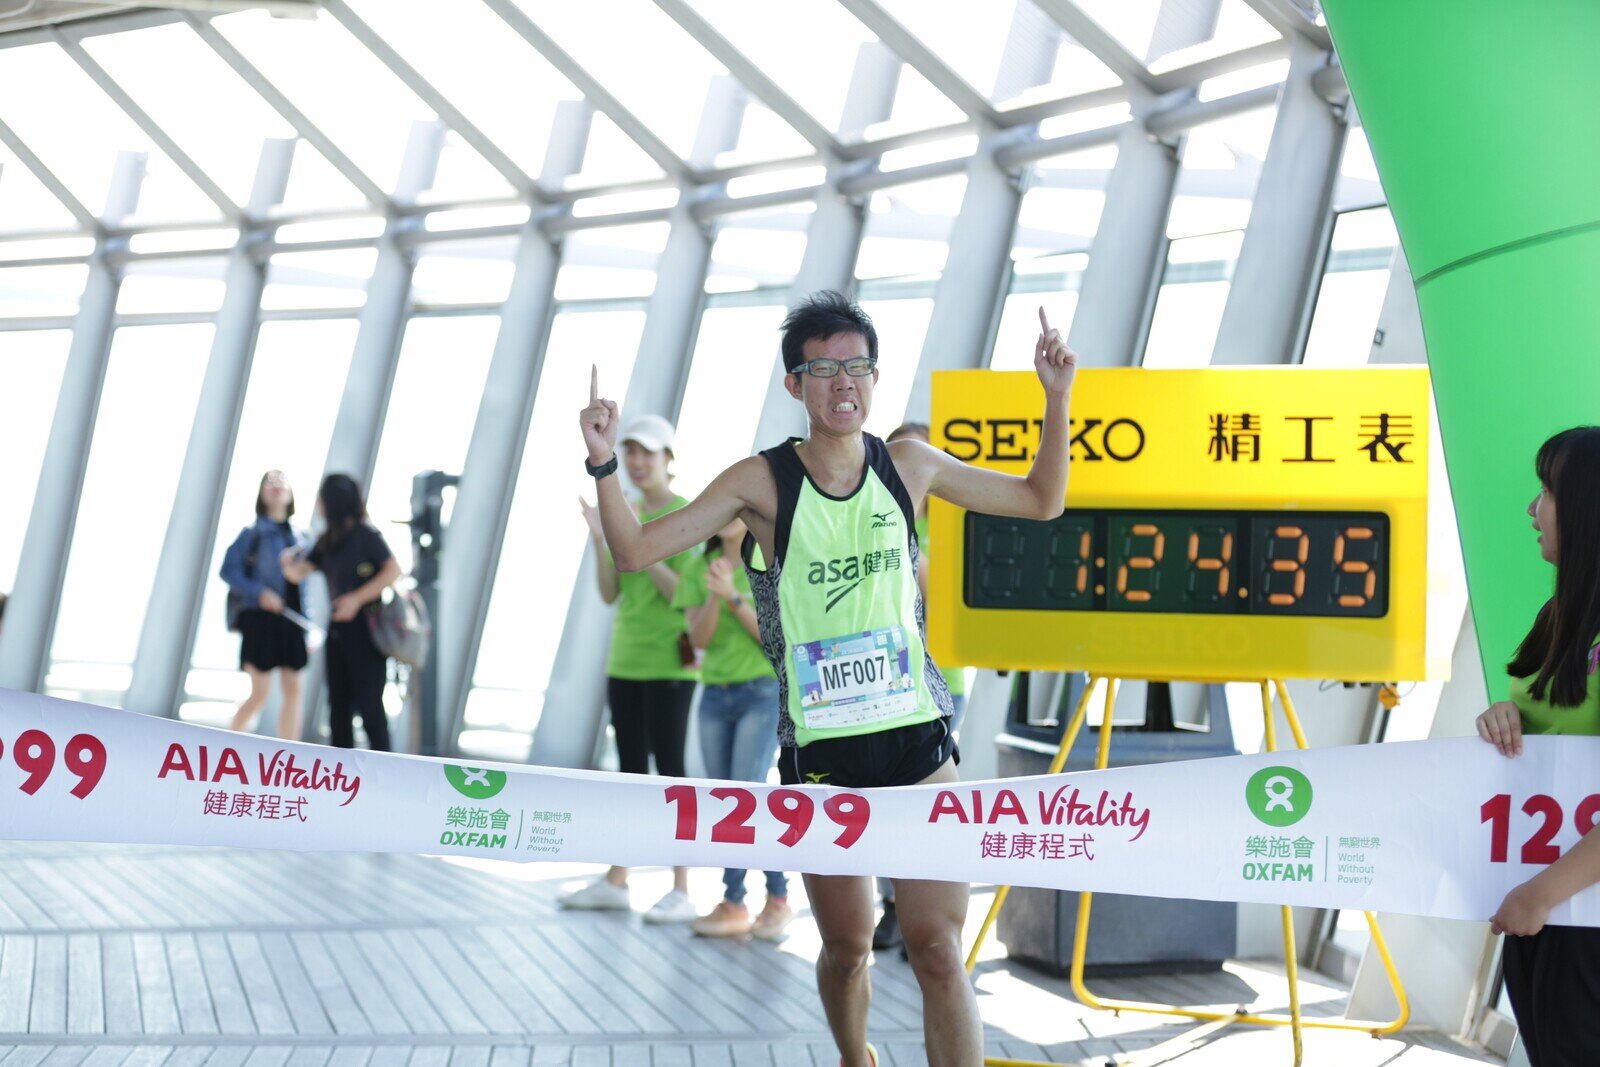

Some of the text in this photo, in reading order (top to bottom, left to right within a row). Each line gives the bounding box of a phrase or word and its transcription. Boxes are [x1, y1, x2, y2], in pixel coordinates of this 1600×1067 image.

[1207, 411, 1415, 463] 精工表
[808, 548, 901, 585] asa 健青
[822, 655, 885, 691] MF007
[0, 729, 107, 800] 99
[157, 743, 361, 807] AIA Vitality
[203, 789, 309, 822] 健康程式
[445, 805, 511, 830] 樂施會
[664, 784, 871, 849] 1299
[928, 784, 1150, 842] AIA Vitality
[439, 831, 507, 849] OXFAM
[529, 836, 564, 845] Without
[531, 826, 556, 835] World
[527, 844, 561, 854] Poverty
[980, 831, 1095, 861] 健康程式
[1245, 835, 1315, 859] 樂施會
[1338, 852, 1365, 862] World
[1242, 862, 1314, 882] OXFAM
[1337, 864, 1375, 874] Without
[1337, 875, 1373, 885] Poverty
